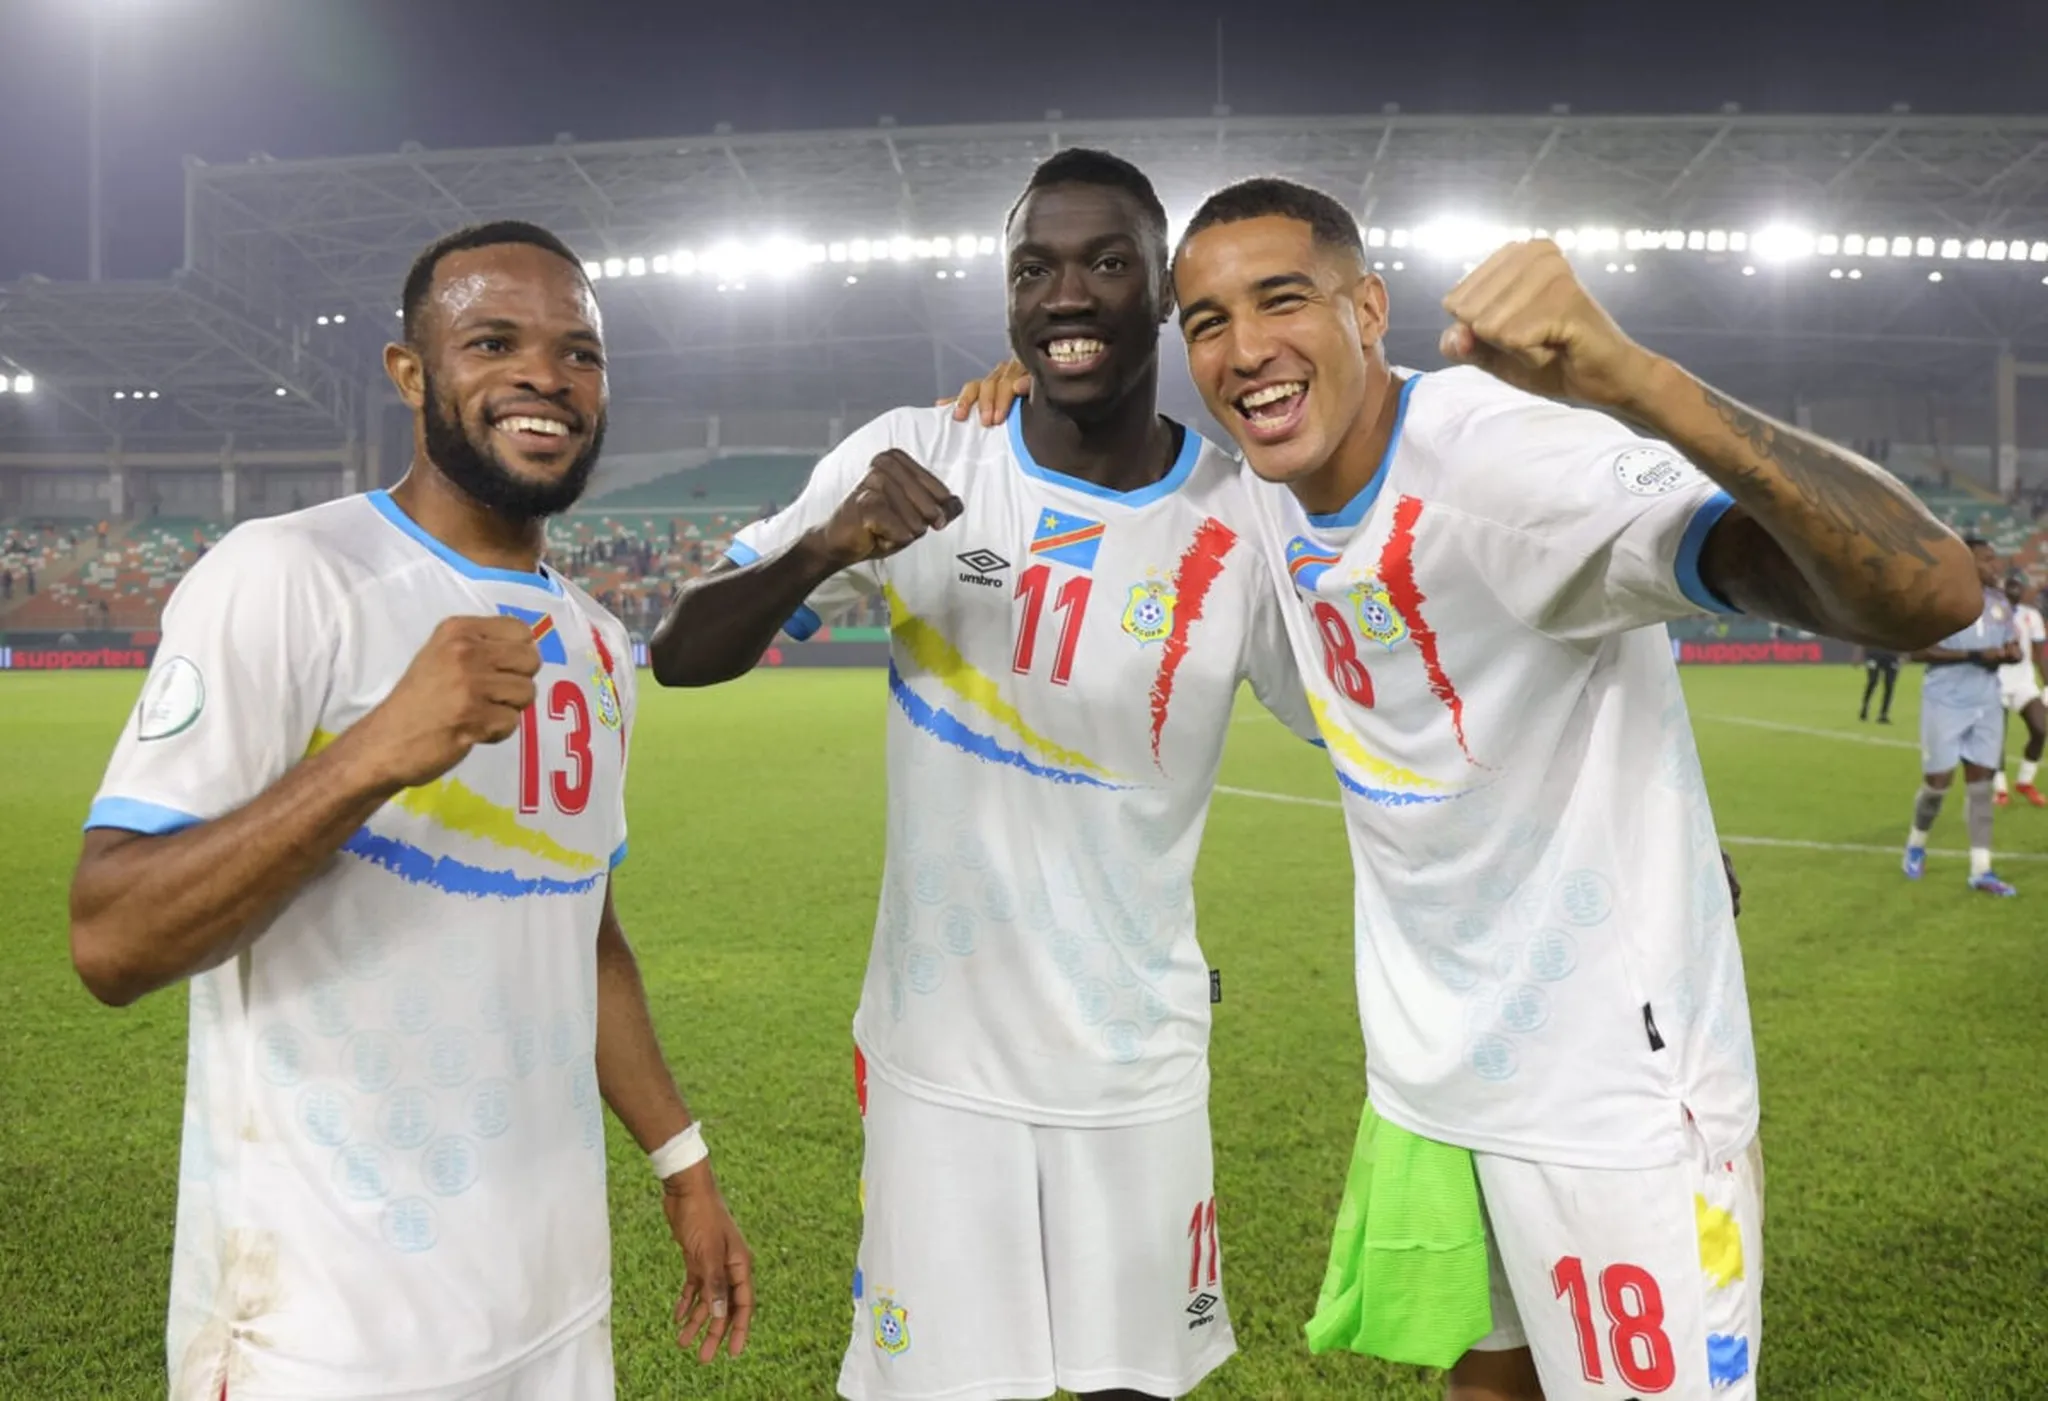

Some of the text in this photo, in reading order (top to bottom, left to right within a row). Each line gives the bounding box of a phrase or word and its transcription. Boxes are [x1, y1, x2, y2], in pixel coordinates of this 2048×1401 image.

[959, 573, 1003, 588] umbro
[1011, 564, 1093, 687] 11
[13, 648, 146, 669] supporters
[1309, 601, 1375, 709] 8
[1681, 641, 1823, 663] supporters
[519, 680, 593, 815] 13
[1188, 1195, 1217, 1294] 11
[1551, 1256, 1676, 1394] 18
